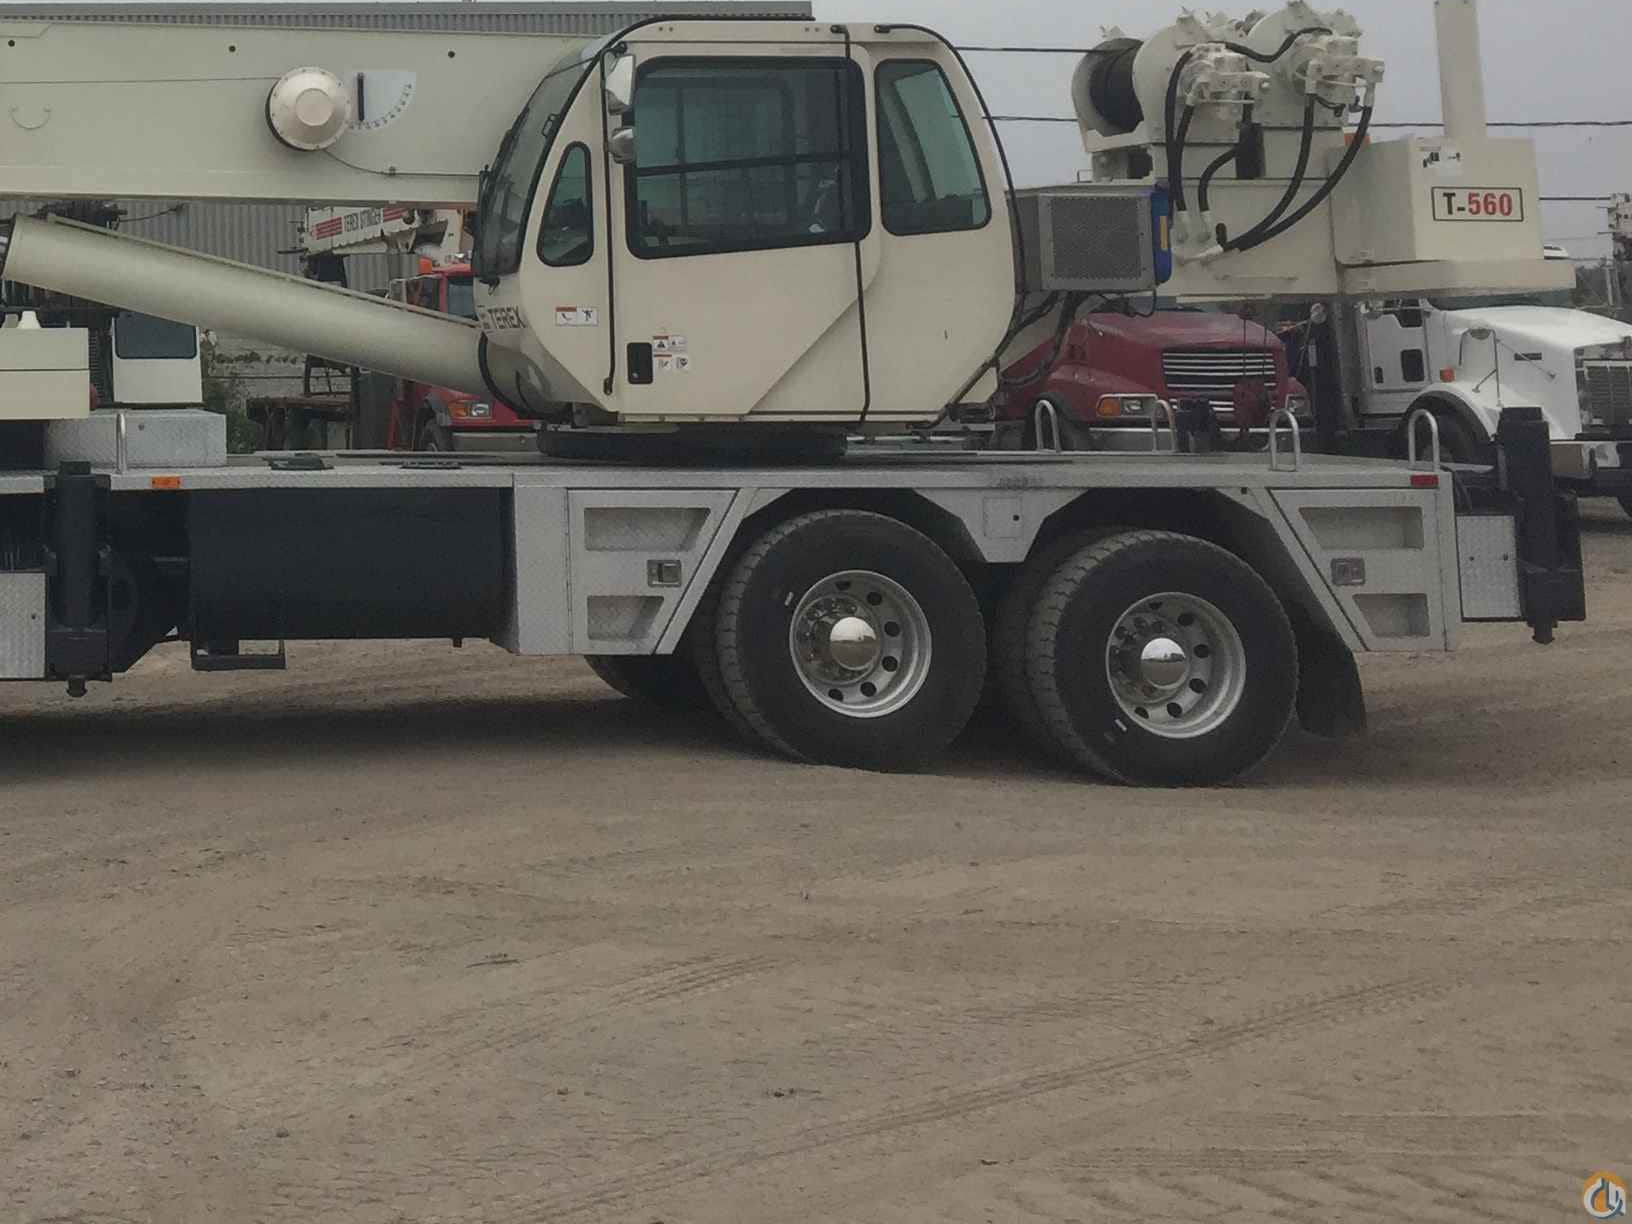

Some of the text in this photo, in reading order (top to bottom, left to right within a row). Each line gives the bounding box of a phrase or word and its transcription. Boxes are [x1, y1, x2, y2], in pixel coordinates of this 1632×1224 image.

[1443, 192, 1513, 216] T-560
[344, 212, 359, 232] TEREX
[487, 306, 526, 329] TEREX
